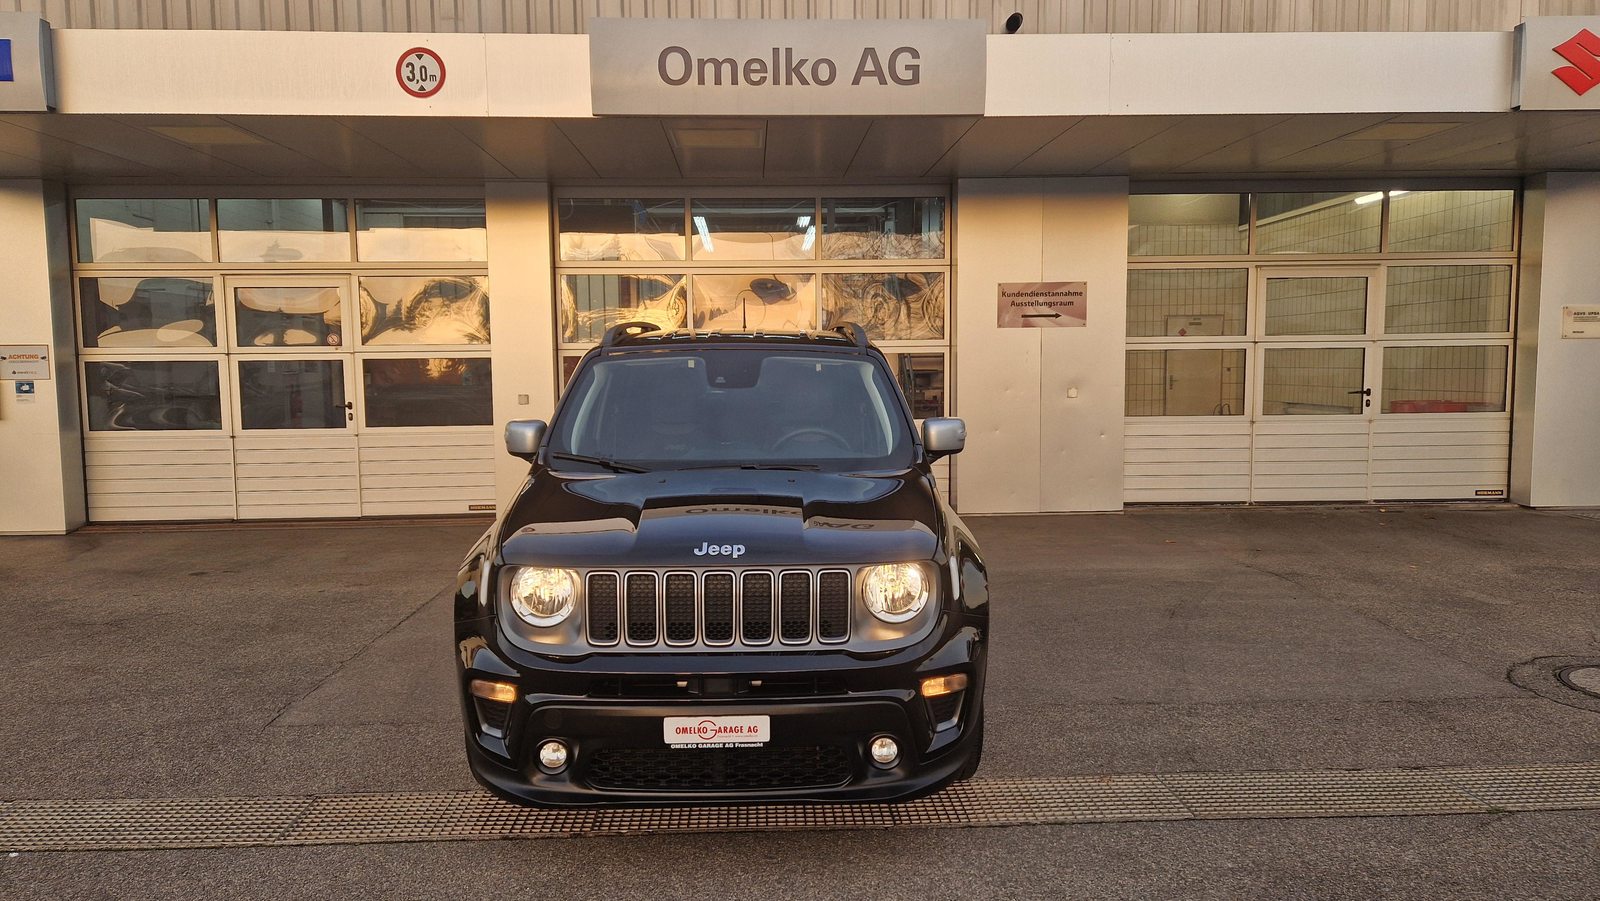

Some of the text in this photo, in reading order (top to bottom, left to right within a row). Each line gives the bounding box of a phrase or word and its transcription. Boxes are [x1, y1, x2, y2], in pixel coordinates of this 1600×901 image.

[657, 45, 921, 86] Omelko AG
[1001, 290, 1083, 298] Kundendienstannahme
[1010, 300, 1074, 308] Ausstellungsraum
[693, 541, 746, 558] Jeep
[675, 726, 708, 735] OMELKO
[747, 725, 759, 733] AG
